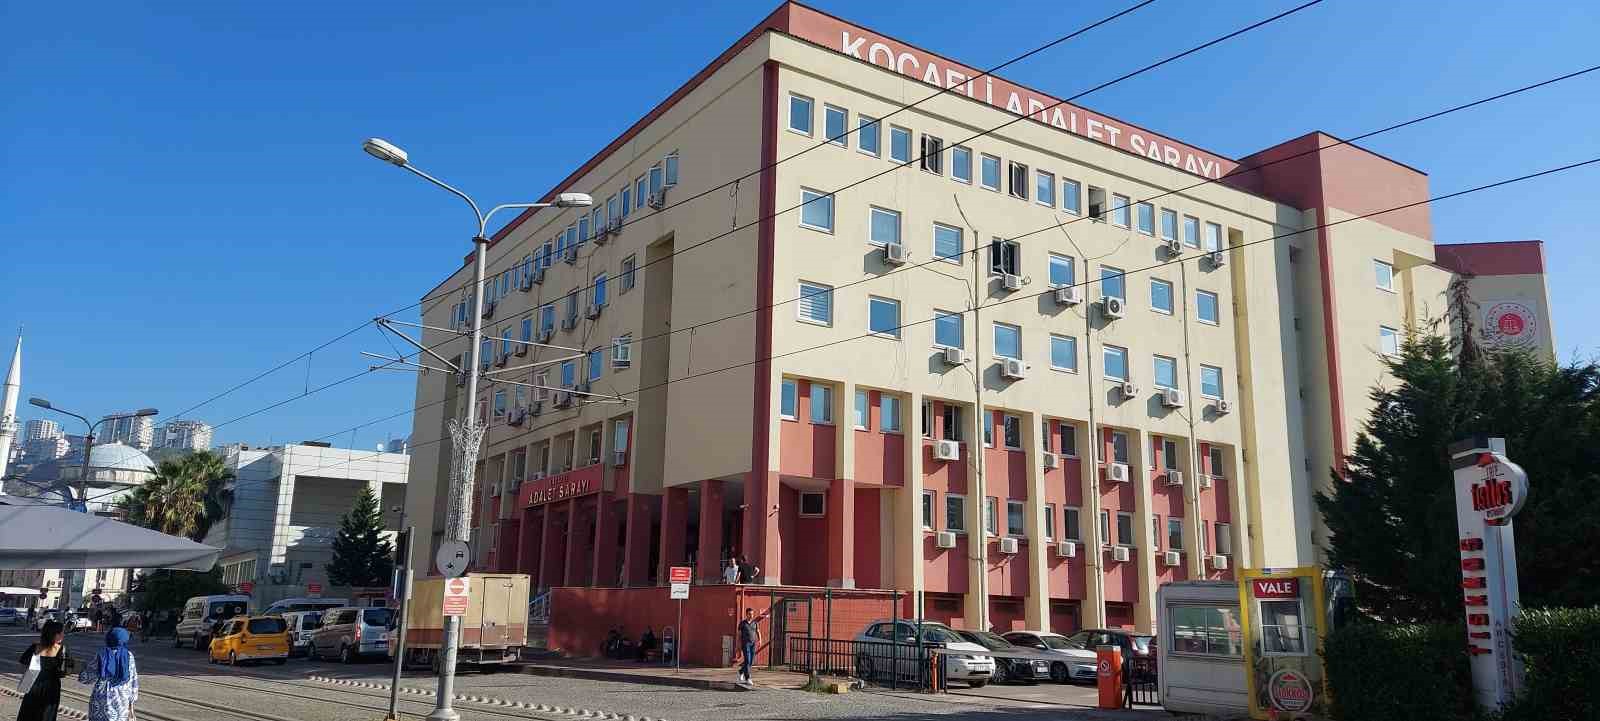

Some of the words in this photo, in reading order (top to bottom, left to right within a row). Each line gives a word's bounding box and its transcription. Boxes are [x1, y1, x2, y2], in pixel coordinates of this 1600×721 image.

[528, 487, 556, 505] ADALET
[558, 479, 589, 498] SARAYI
[1259, 582, 1293, 594] VALE
